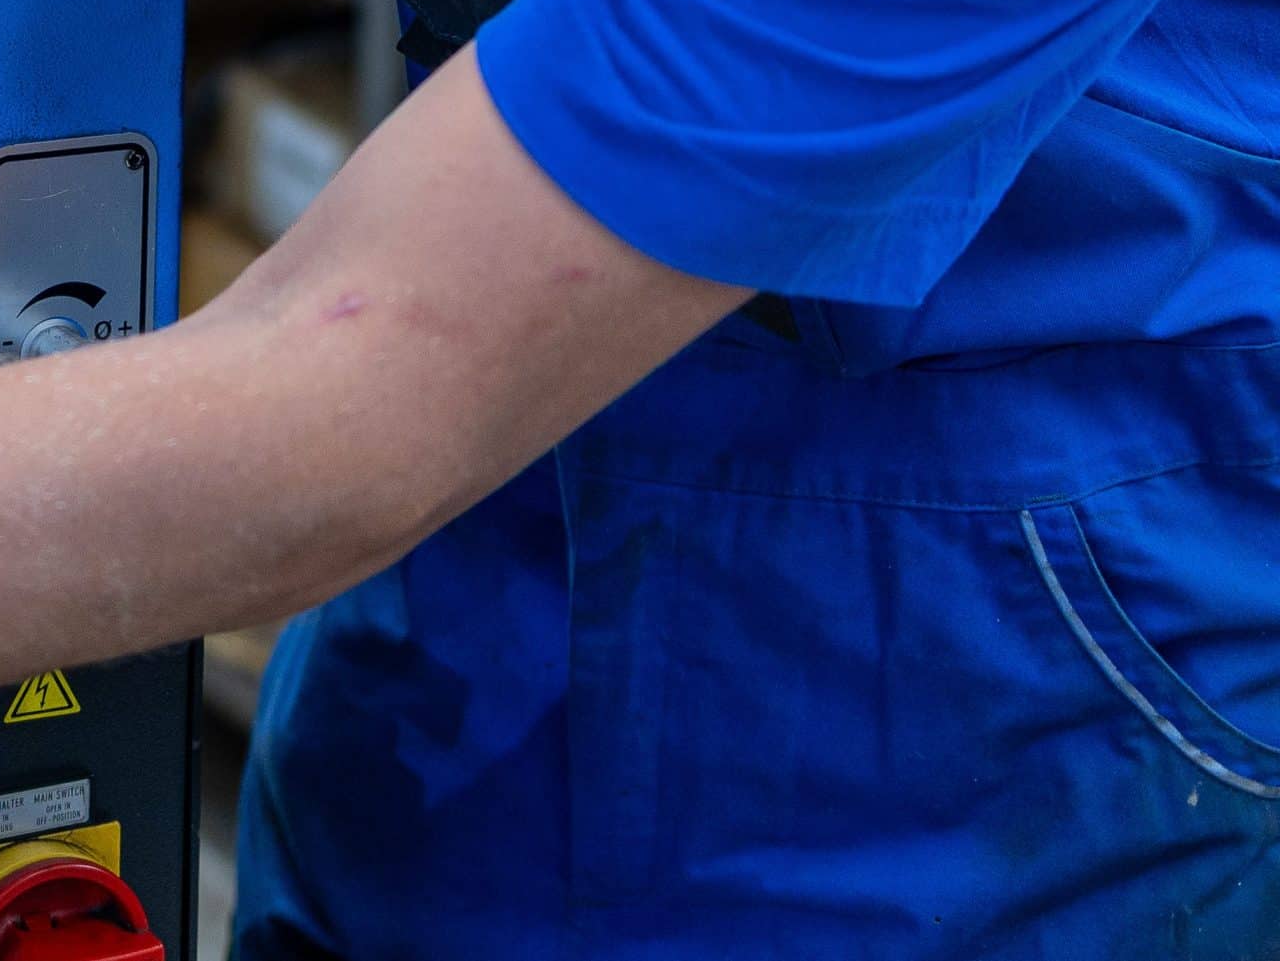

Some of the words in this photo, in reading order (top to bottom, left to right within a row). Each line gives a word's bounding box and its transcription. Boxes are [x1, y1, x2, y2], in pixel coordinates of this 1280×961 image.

[33, 791, 53, 803] MAIN
[55, 785, 85, 800] SWITCH
[53, 810, 81, 823] POSITION
